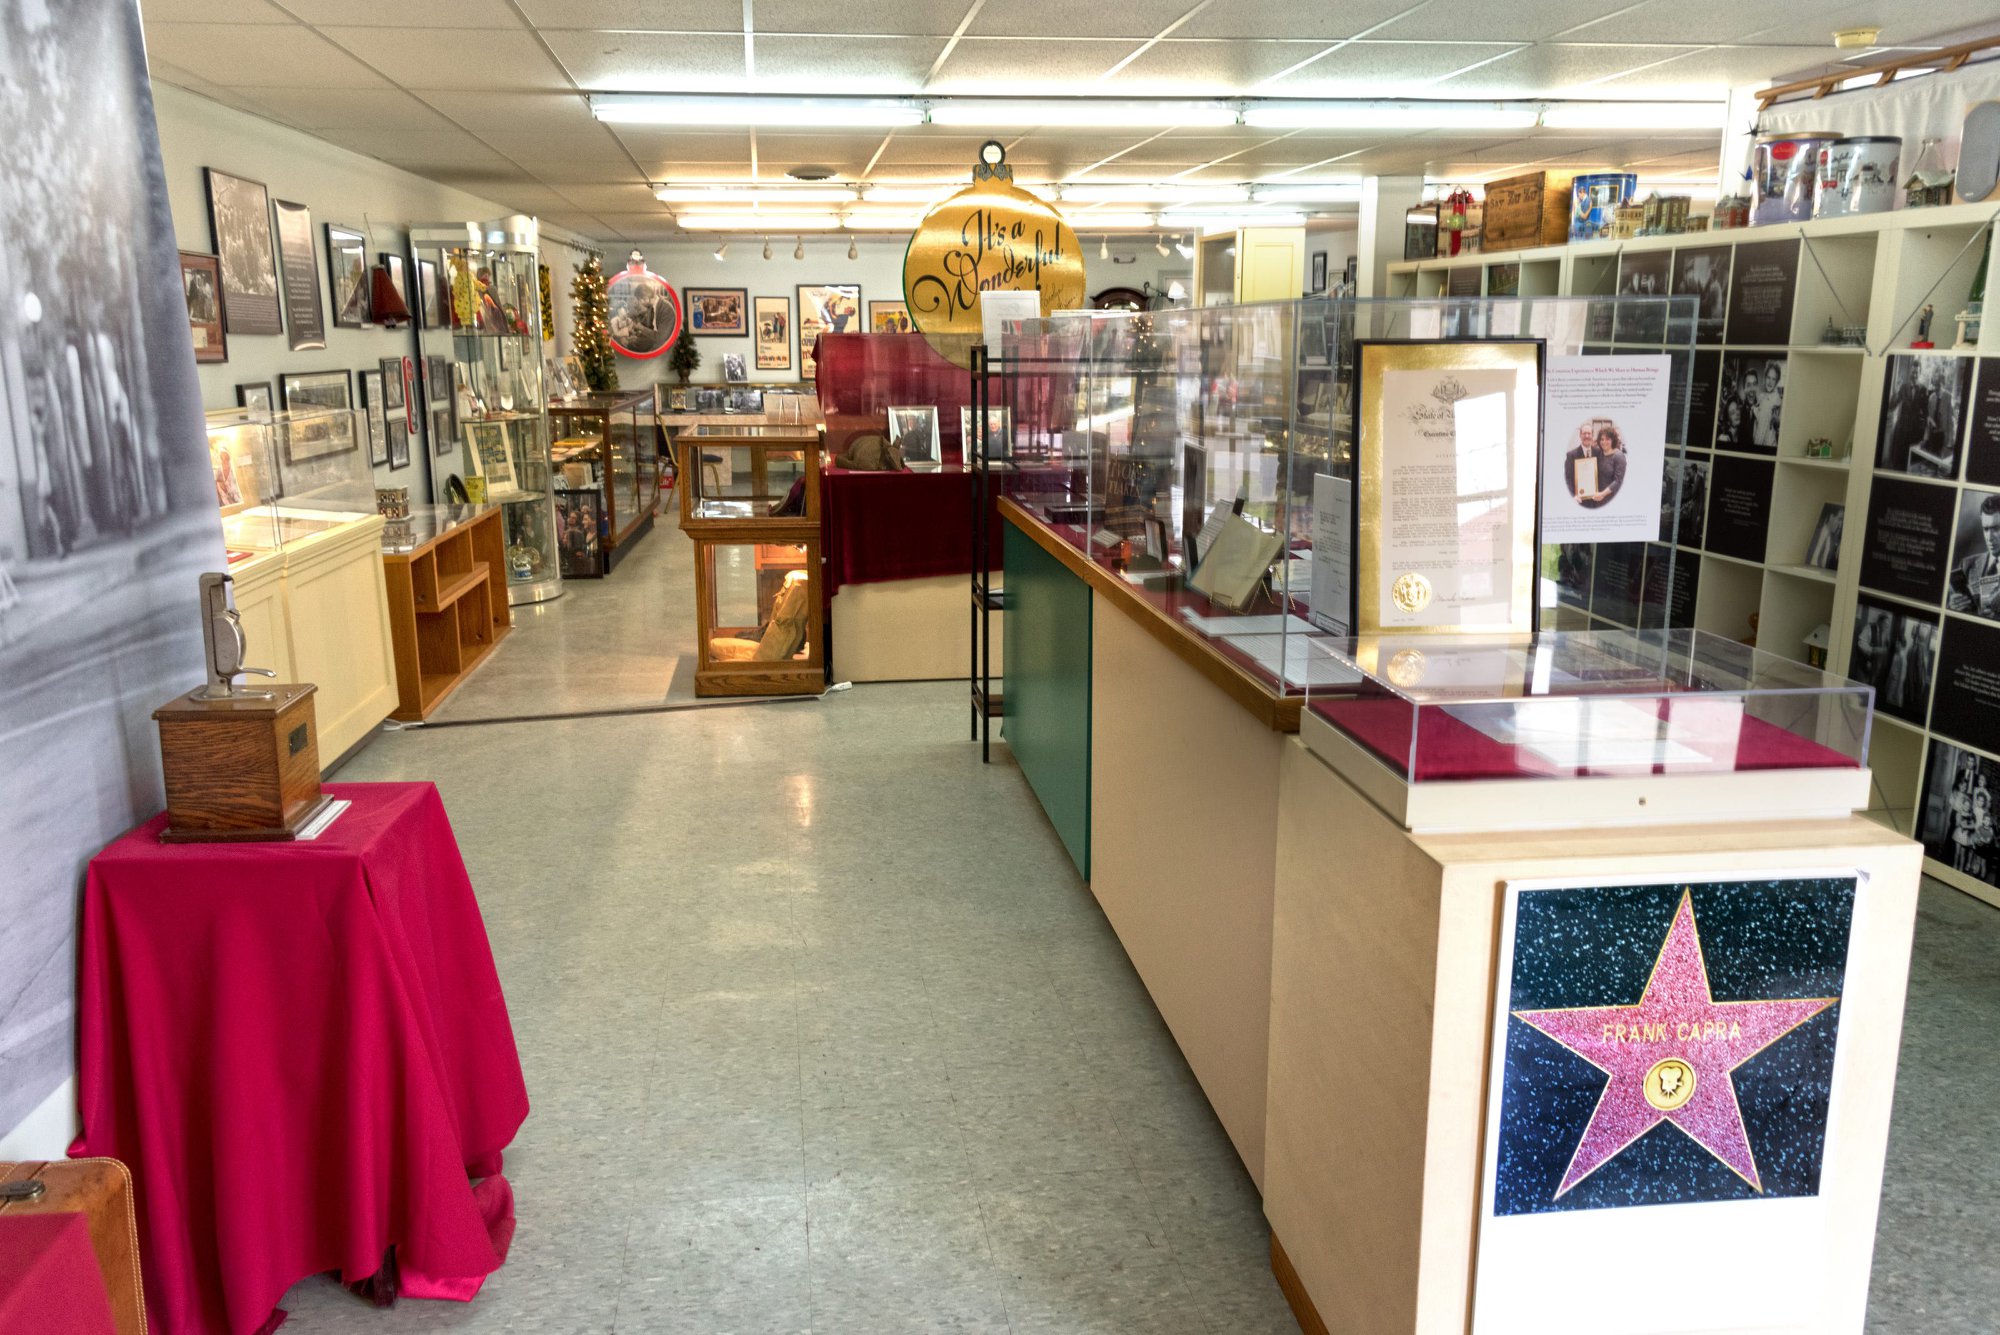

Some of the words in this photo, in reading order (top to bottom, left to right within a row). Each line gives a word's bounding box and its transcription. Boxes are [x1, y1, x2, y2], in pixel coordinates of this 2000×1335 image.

[962, 209, 1006, 265] It's
[1011, 219, 1025, 238] a
[912, 221, 1064, 322] Wonderful
[1602, 1022, 1667, 1043] FRANK
[1677, 1020, 1742, 1042] CAPRA
